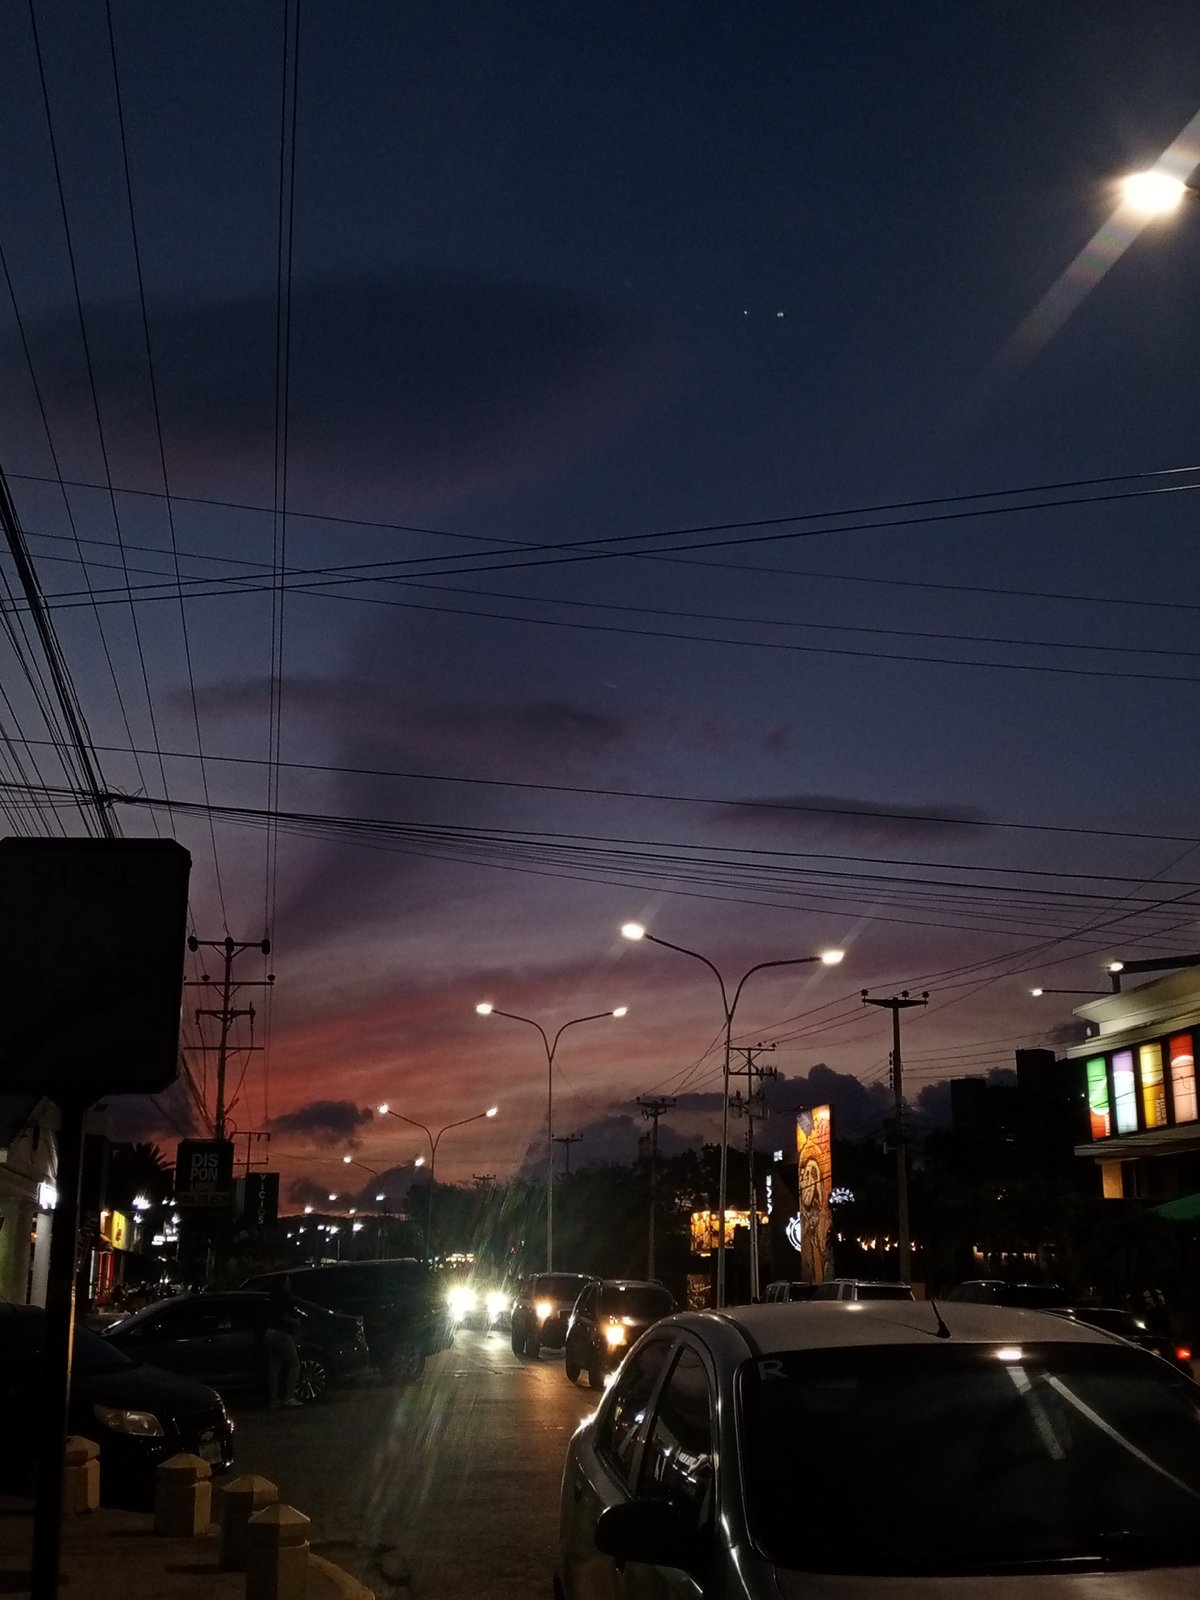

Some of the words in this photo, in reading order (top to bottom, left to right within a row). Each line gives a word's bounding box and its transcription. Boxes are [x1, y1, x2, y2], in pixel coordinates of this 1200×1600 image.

[191, 1152, 219, 1168] DIS
[190, 1167, 218, 1182] PON
[257, 1173, 266, 1225] VICIOS
